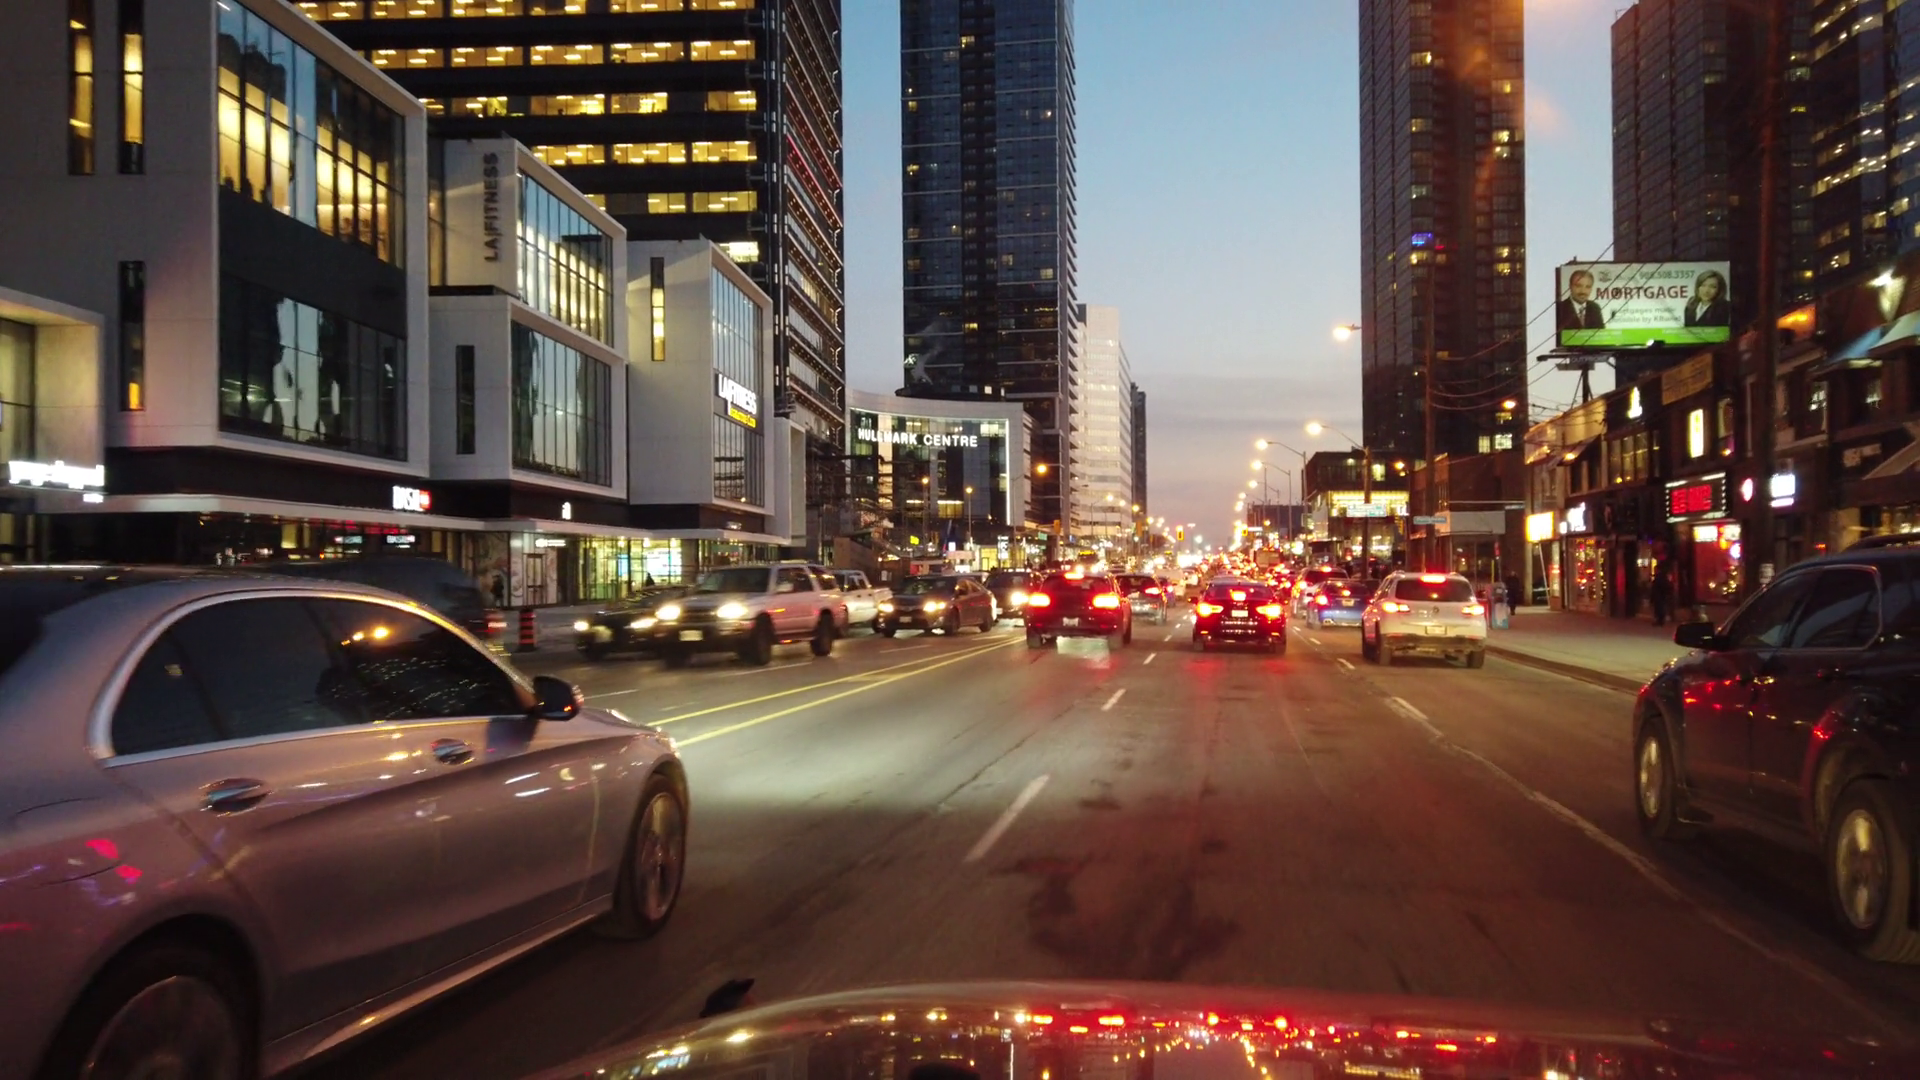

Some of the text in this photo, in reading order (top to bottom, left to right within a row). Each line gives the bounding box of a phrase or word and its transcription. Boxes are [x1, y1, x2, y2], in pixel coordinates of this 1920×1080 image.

[1596, 285, 1689, 300] MORTGAGE
[858, 427, 978, 447] HULLMARK CENTRE
